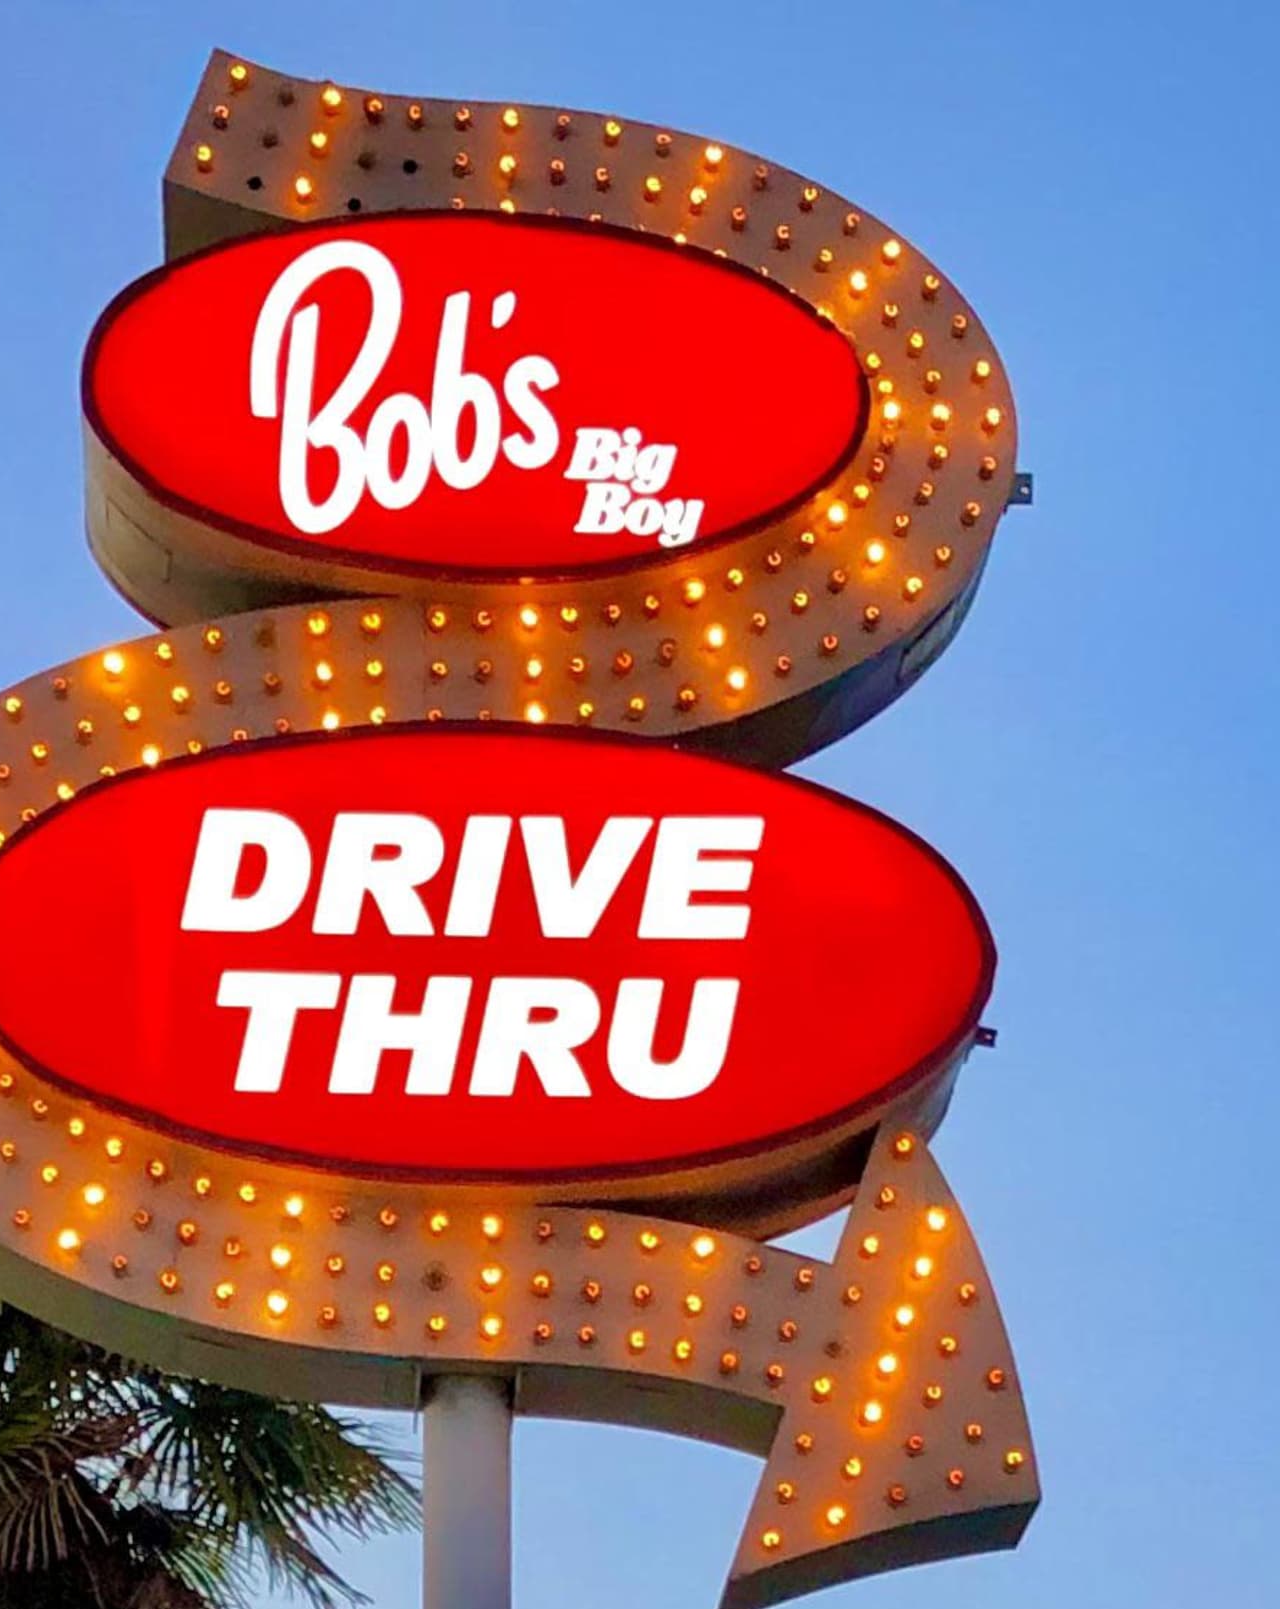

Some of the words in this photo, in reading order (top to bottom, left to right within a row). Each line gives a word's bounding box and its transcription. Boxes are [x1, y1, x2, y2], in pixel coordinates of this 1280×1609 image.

[250, 239, 560, 534] Bob's
[564, 427, 677, 494] Big
[573, 481, 704, 548] Boy
[180, 807, 766, 940] DRIVE
[215, 969, 741, 1100] THRU
